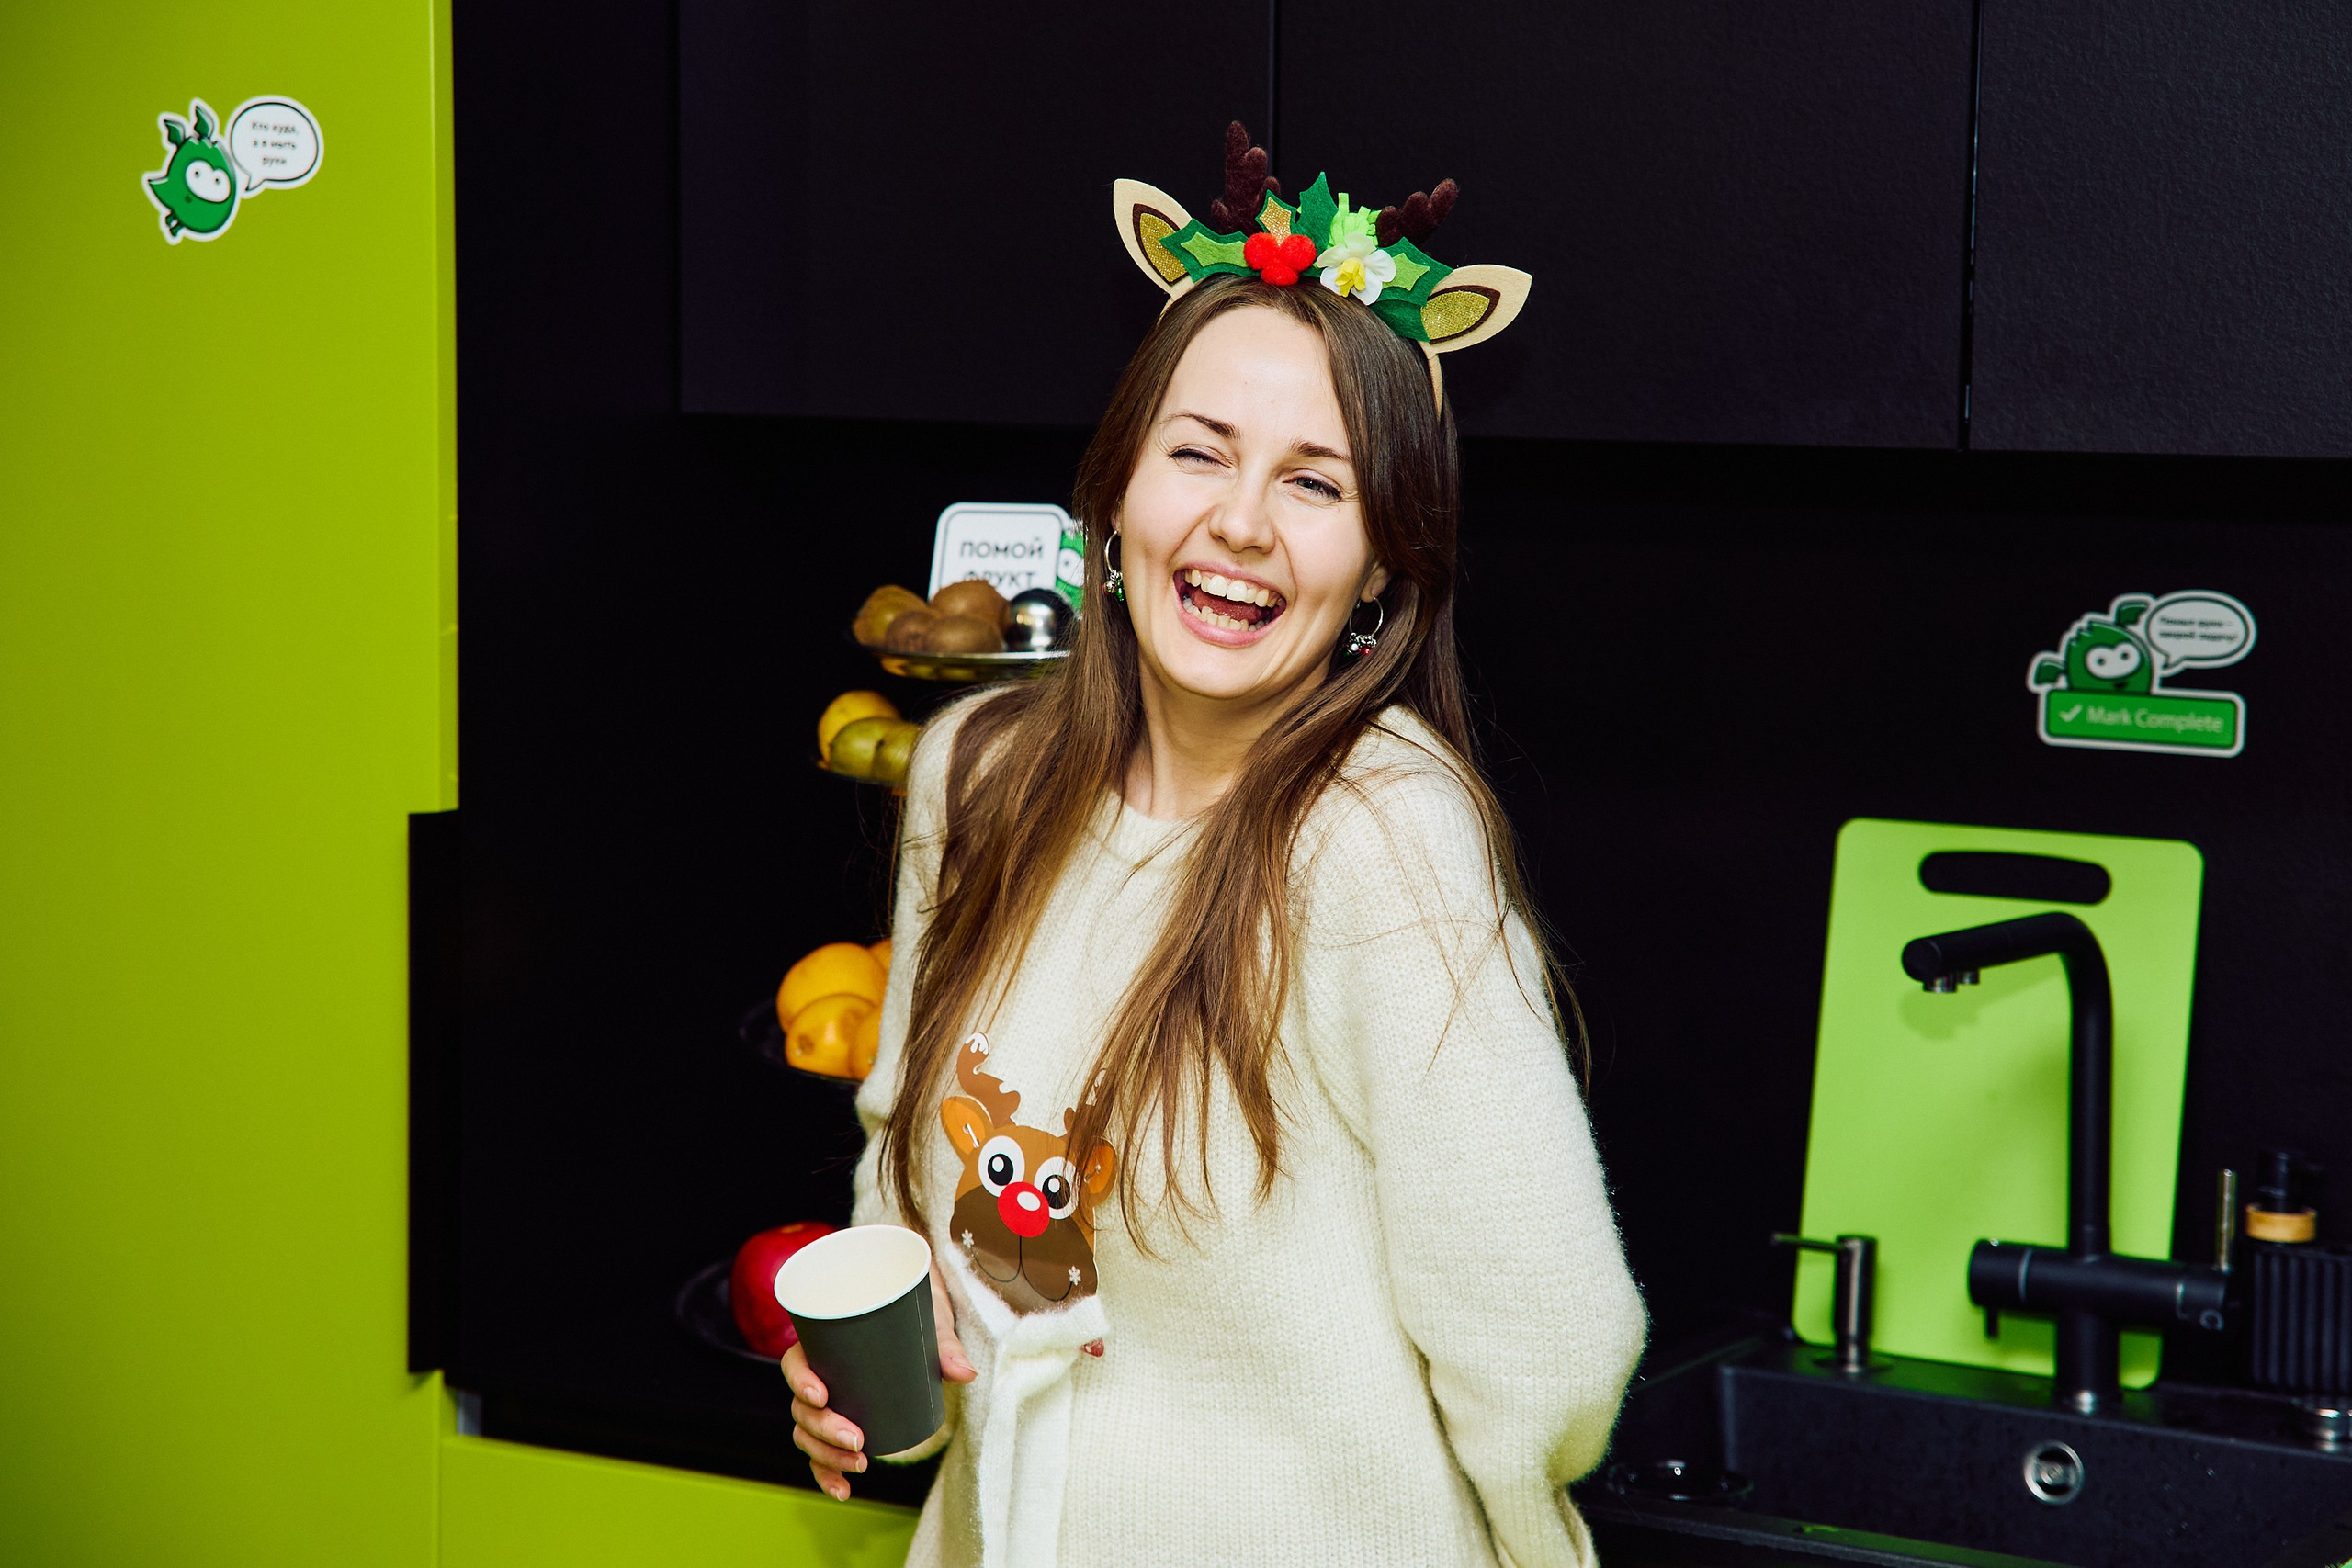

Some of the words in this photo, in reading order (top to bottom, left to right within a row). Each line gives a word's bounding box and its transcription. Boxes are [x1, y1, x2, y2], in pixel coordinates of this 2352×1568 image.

[960, 536, 1043, 559] ПОМОЙ
[2086, 705, 2131, 726] Mark
[2134, 707, 2223, 734] Complete
